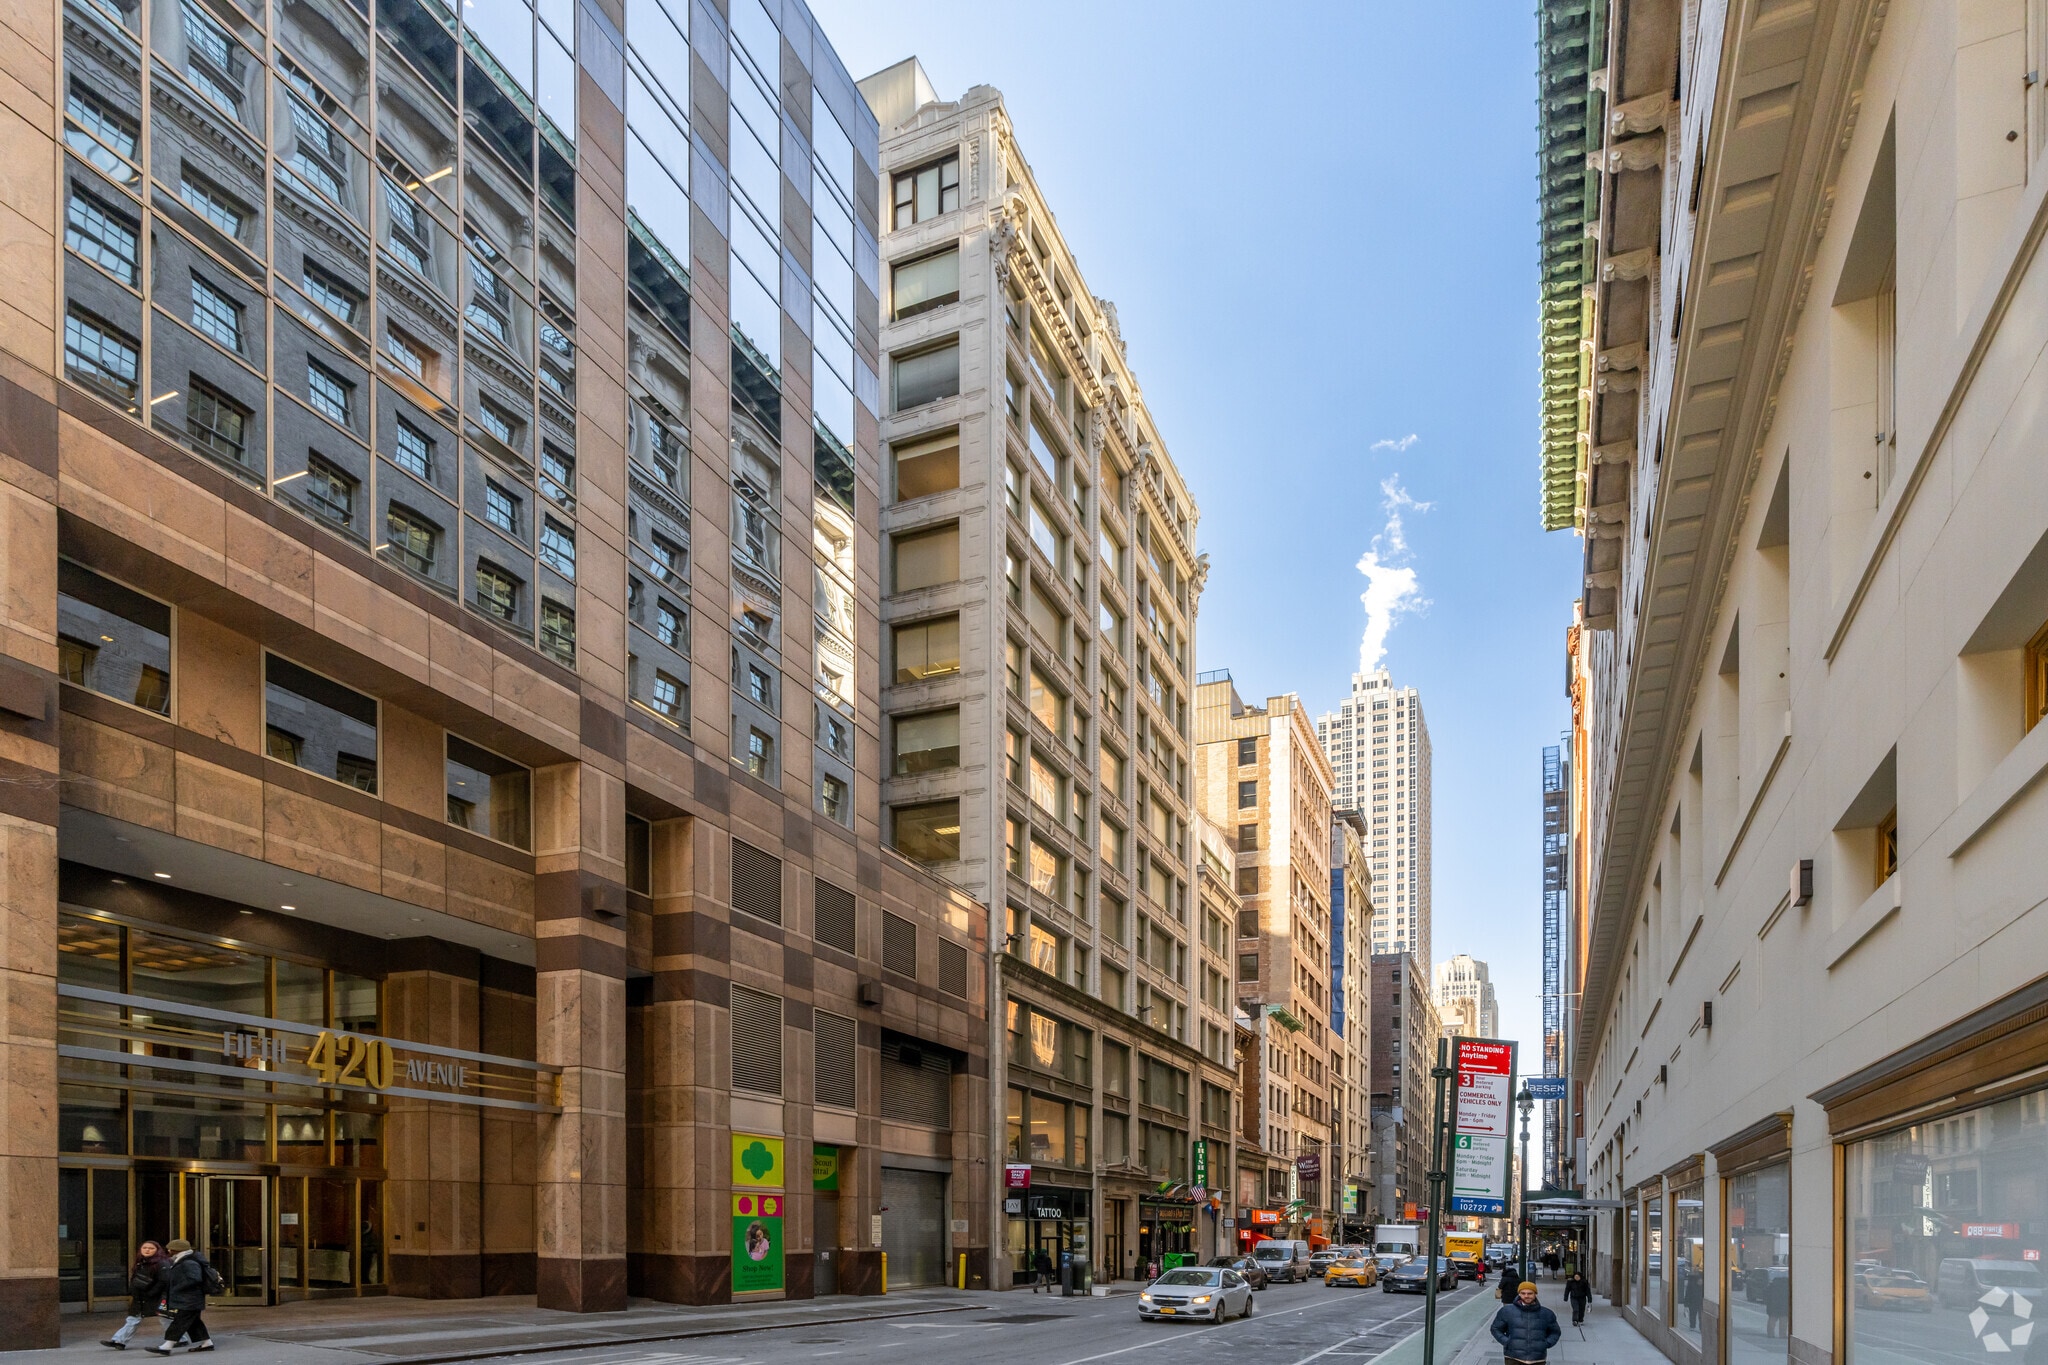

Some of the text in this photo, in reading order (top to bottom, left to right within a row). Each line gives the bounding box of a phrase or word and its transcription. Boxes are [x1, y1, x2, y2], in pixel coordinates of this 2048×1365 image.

[1461, 1044, 1504, 1054] NO STANDING
[1461, 1052, 1488, 1060] Anytime
[223, 1031, 469, 1091] FIFTH 420 AVENUE
[1461, 1074, 1471, 1086] 3
[1529, 1084, 1565, 1092] BESEN
[1459, 1091, 1496, 1100] COMMERCIAL
[1459, 1098, 1487, 1106] VEHICLES
[1458, 1136, 1468, 1148] 6
[814, 1158, 832, 1167] Scout
[1460, 1204, 1487, 1212] 102727
[1037, 1208, 1061, 1218] TATTOO
[742, 1264, 758, 1273] Shop
